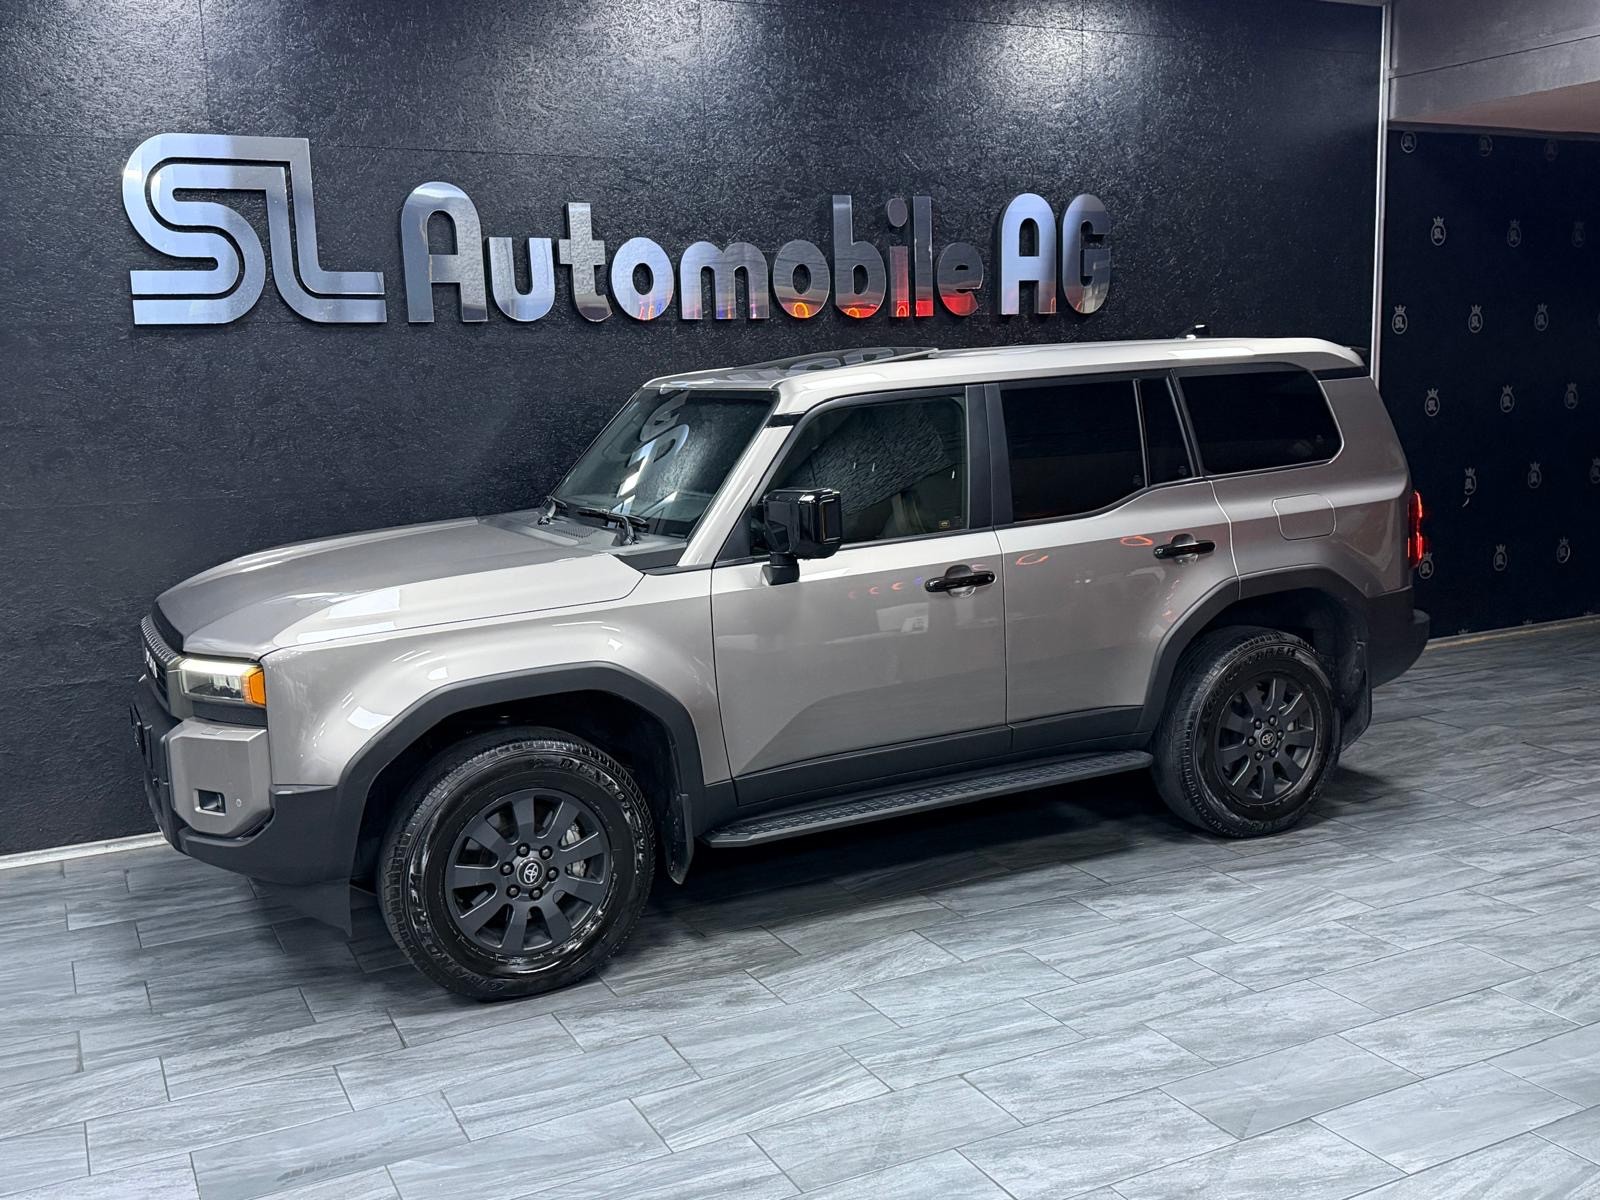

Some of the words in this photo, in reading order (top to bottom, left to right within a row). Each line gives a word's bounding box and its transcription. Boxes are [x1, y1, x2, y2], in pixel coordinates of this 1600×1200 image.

[122, 133, 387, 325] SL
[401, 181, 984, 323] Automobile
[1000, 193, 1111, 315] AG
